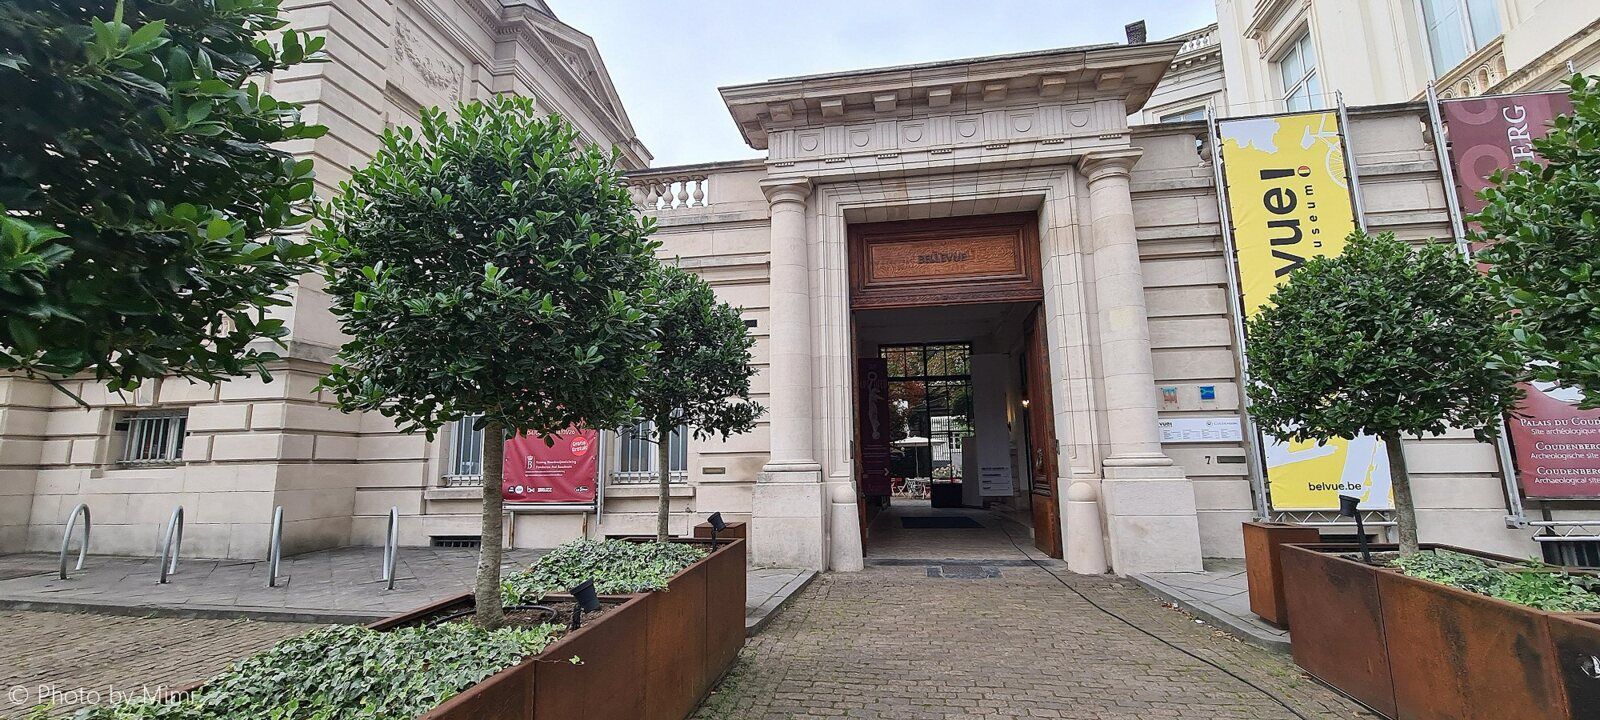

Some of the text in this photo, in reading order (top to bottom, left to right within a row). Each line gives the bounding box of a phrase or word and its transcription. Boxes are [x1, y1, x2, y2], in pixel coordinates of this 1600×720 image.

[1503, 104, 1535, 167] ERG
[1304, 185, 1323, 258] useum
[1546, 427, 1597, 436] archéologique
[1204, 455, 1211, 464] 7
[1530, 452, 1585, 461] Archeologische
[1534, 477, 1587, 486] Archaeological
[1308, 482, 1362, 491] belvue.be
